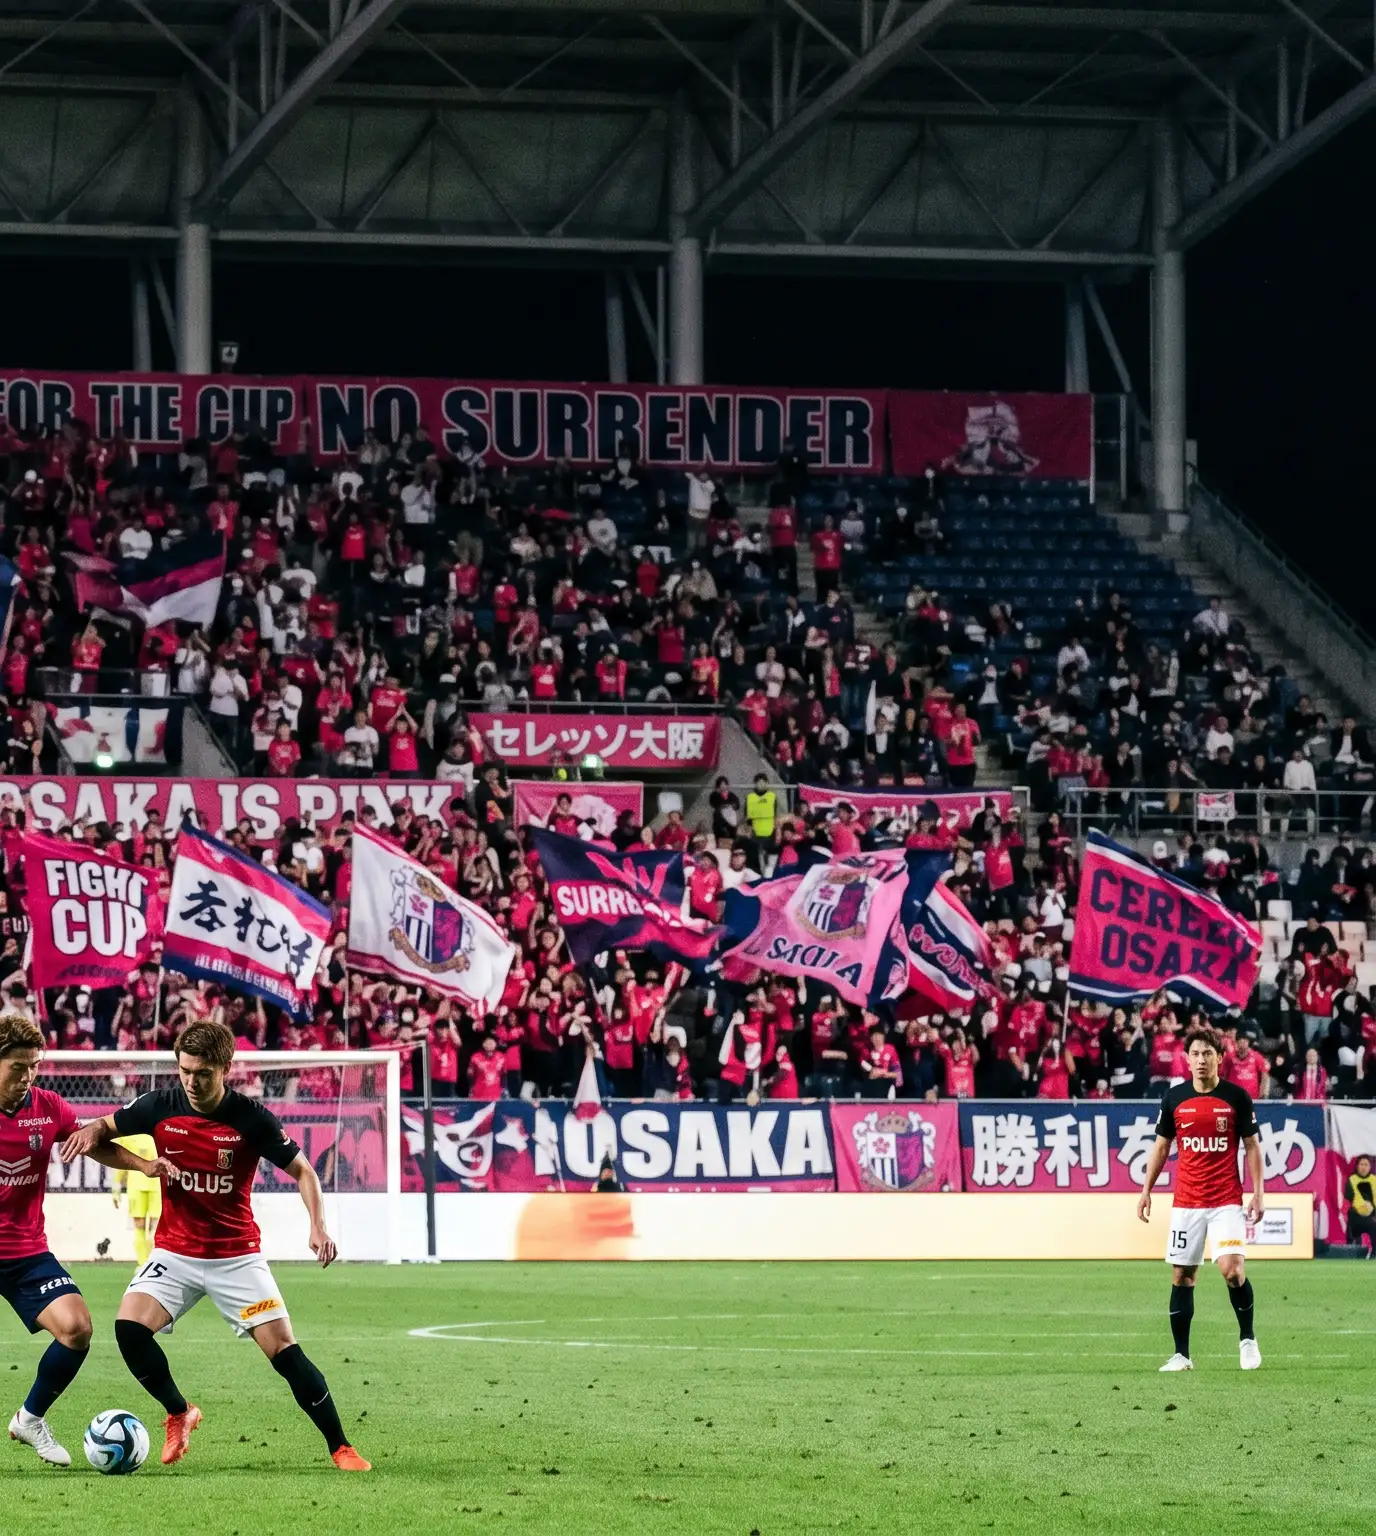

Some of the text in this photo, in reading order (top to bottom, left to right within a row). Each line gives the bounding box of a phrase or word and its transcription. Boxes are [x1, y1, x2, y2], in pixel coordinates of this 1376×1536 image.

[88, 382, 183, 444] THE
[195, 384, 296, 446] CUP
[316, 383, 873, 468] NO SURRENDER
[485, 719, 706, 761] セレッソ大阪
[217, 783, 280, 841] IS
[296, 783, 453, 838] PINK
[44, 859, 149, 908] FIGHT
[51, 898, 148, 958] CUP
[1100, 923, 1241, 989] OSAKA
[971, 1113, 1317, 1188] 勝利をめ
[1181, 1136, 1228, 1153] POLUS
[167, 1170, 234, 1195] OLUS
[1171, 1230, 1188, 1250] 15
[139, 1261, 168, 1279] 15
